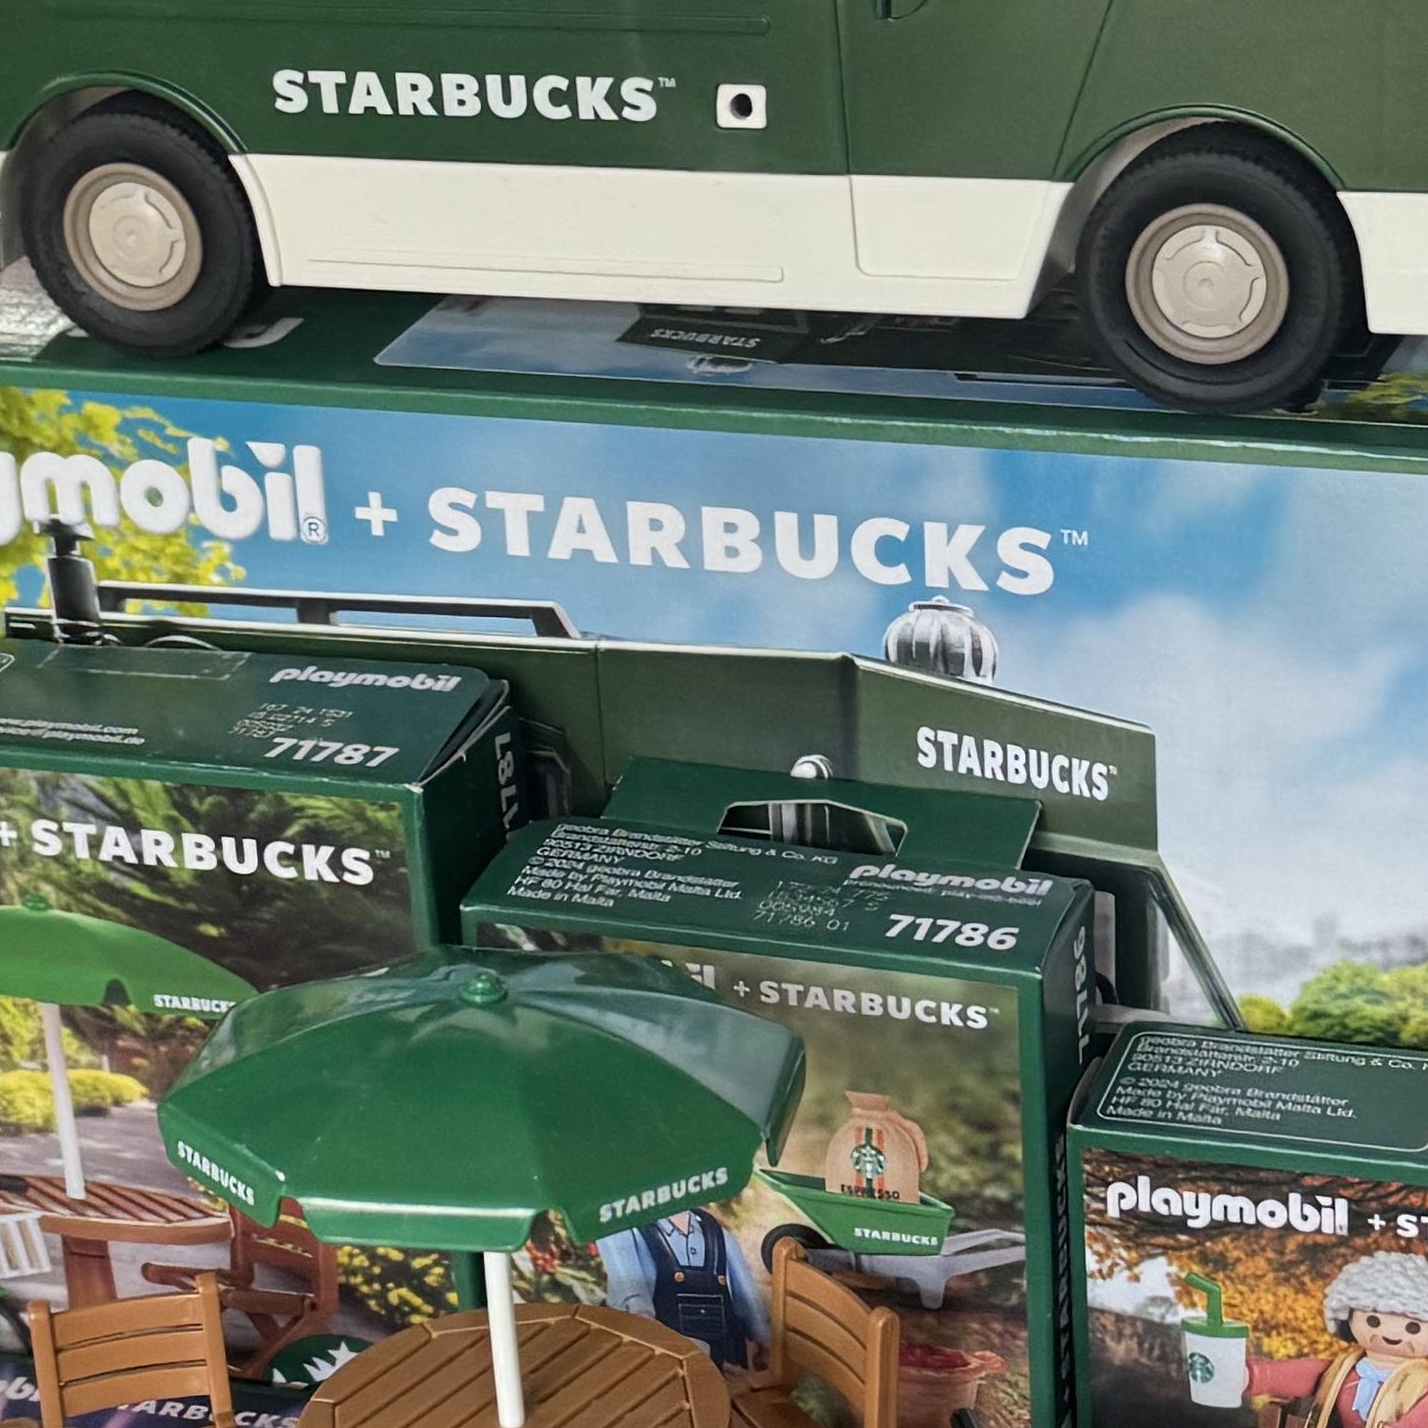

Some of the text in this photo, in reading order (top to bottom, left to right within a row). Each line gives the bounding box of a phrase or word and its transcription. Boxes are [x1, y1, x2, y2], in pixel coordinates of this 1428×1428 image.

[269, 665, 463, 692] playmobil
[265, 736, 401, 769] 71787
[536, 847, 625, 865] GERMANY
[849, 863, 1055, 896] playmobil
[506, 885, 551, 900] Made
[572, 893, 615, 908] Malta
[884, 913, 1021, 951] 71786
[1127, 1061, 1222, 1079] GERMANY
[1106, 1105, 1153, 1119] Made
[1175, 1111, 1223, 1126] Malta
[175, 1139, 256, 1207] STARBUCKS
[598, 1167, 729, 1224] STARBUCKS
[1105, 1174, 1350, 1237] playmobil
[854, 1227, 938, 1246] STARBUCKS
